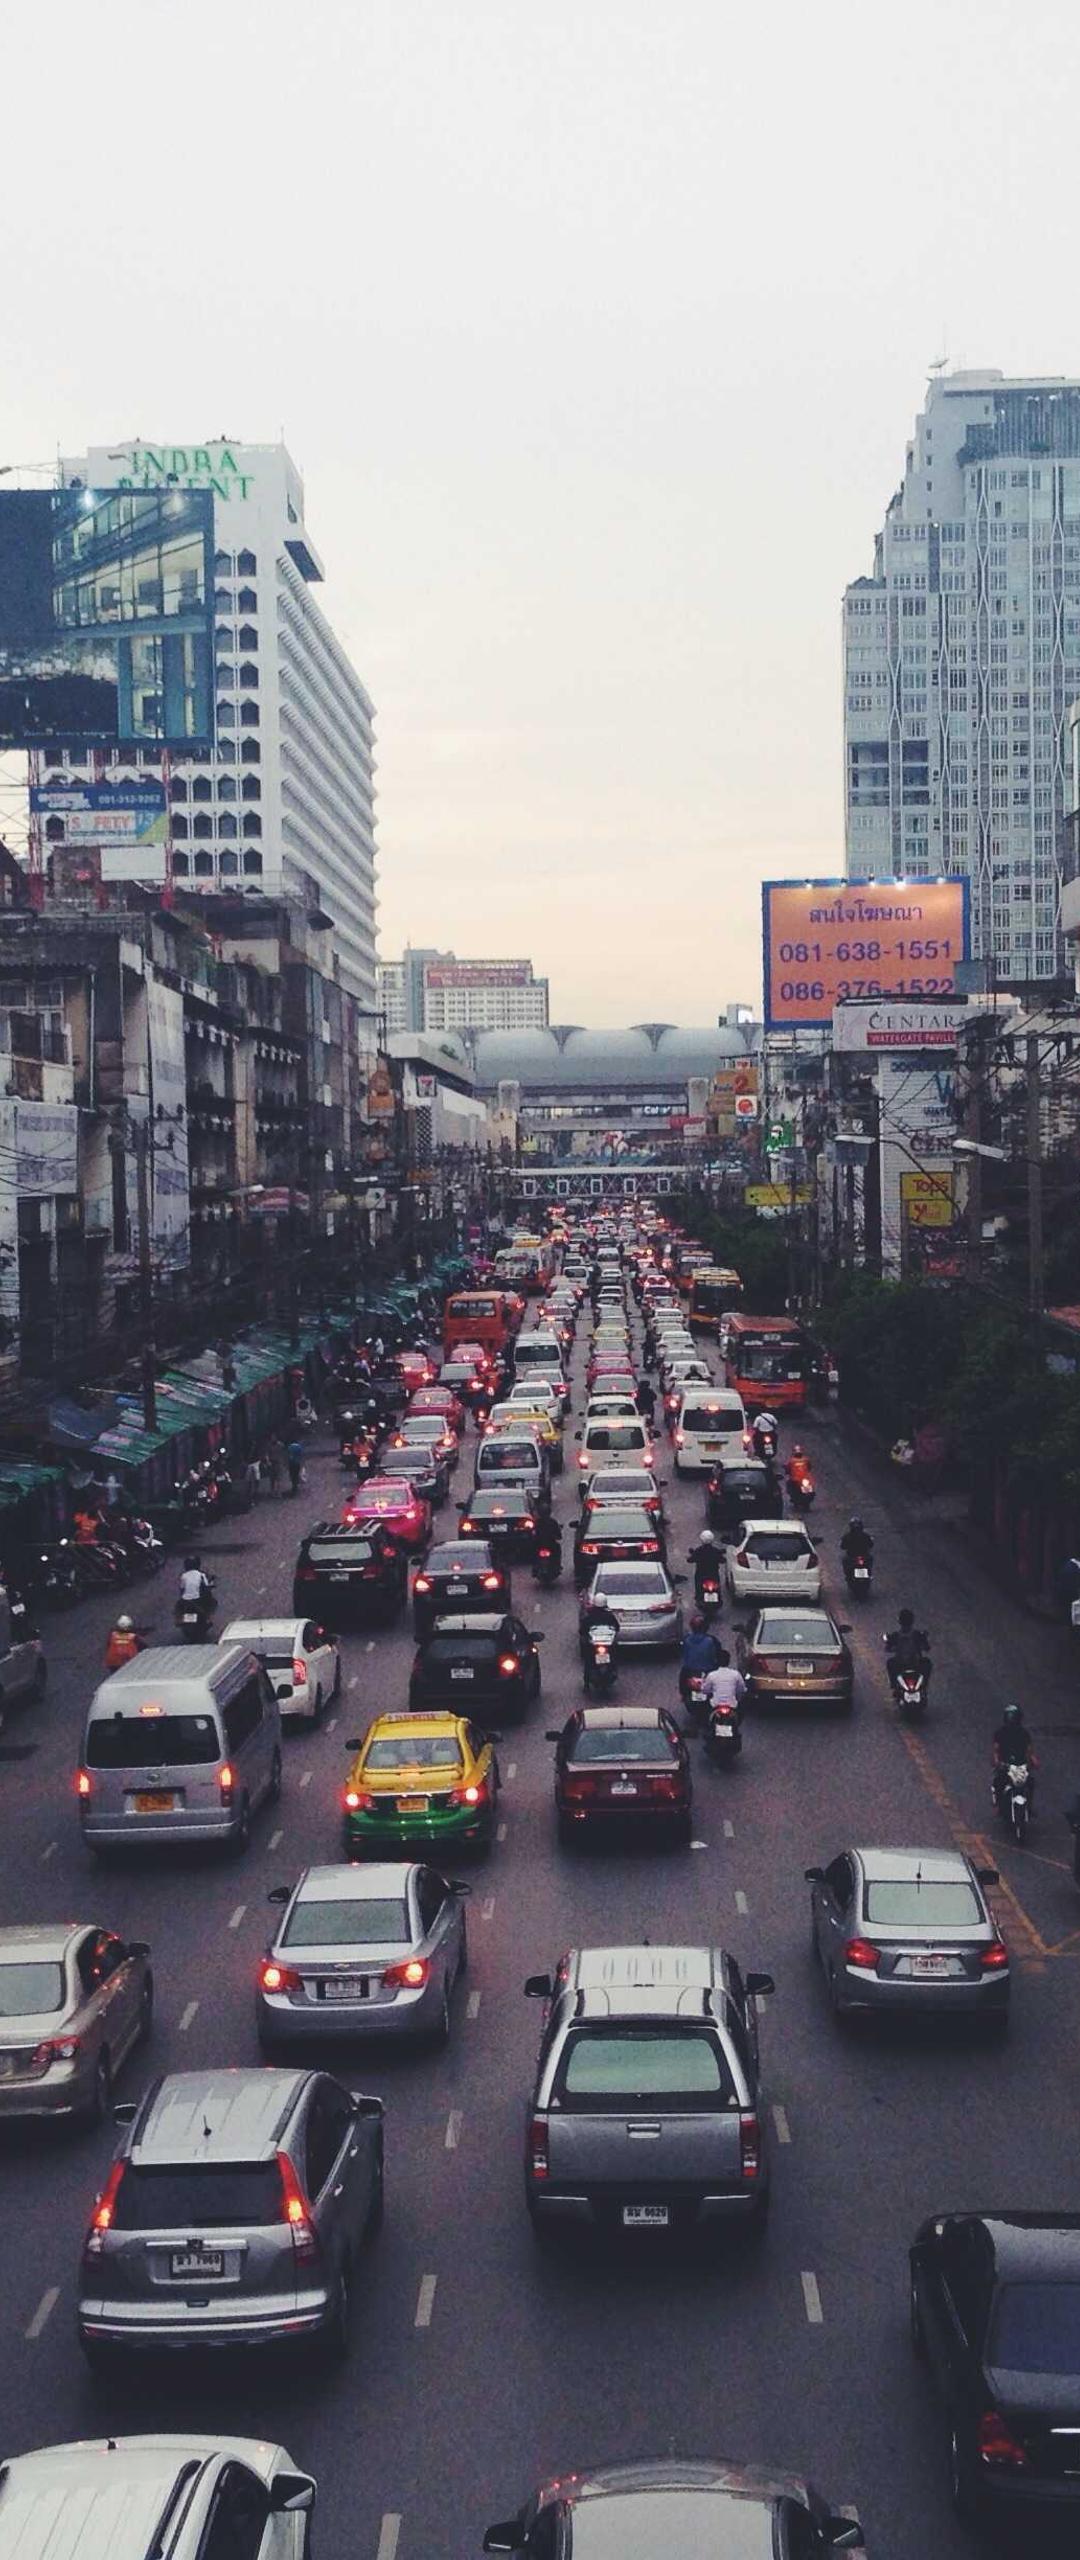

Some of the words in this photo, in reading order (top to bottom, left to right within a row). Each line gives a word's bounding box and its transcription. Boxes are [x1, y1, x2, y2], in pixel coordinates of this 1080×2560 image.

[131, 450, 238, 475] INDRA
[809, 899, 923, 924] สนใจโฆษณา
[779, 940, 952, 963] 081-638-1551
[780, 978, 954, 1001] 086-376-1522
